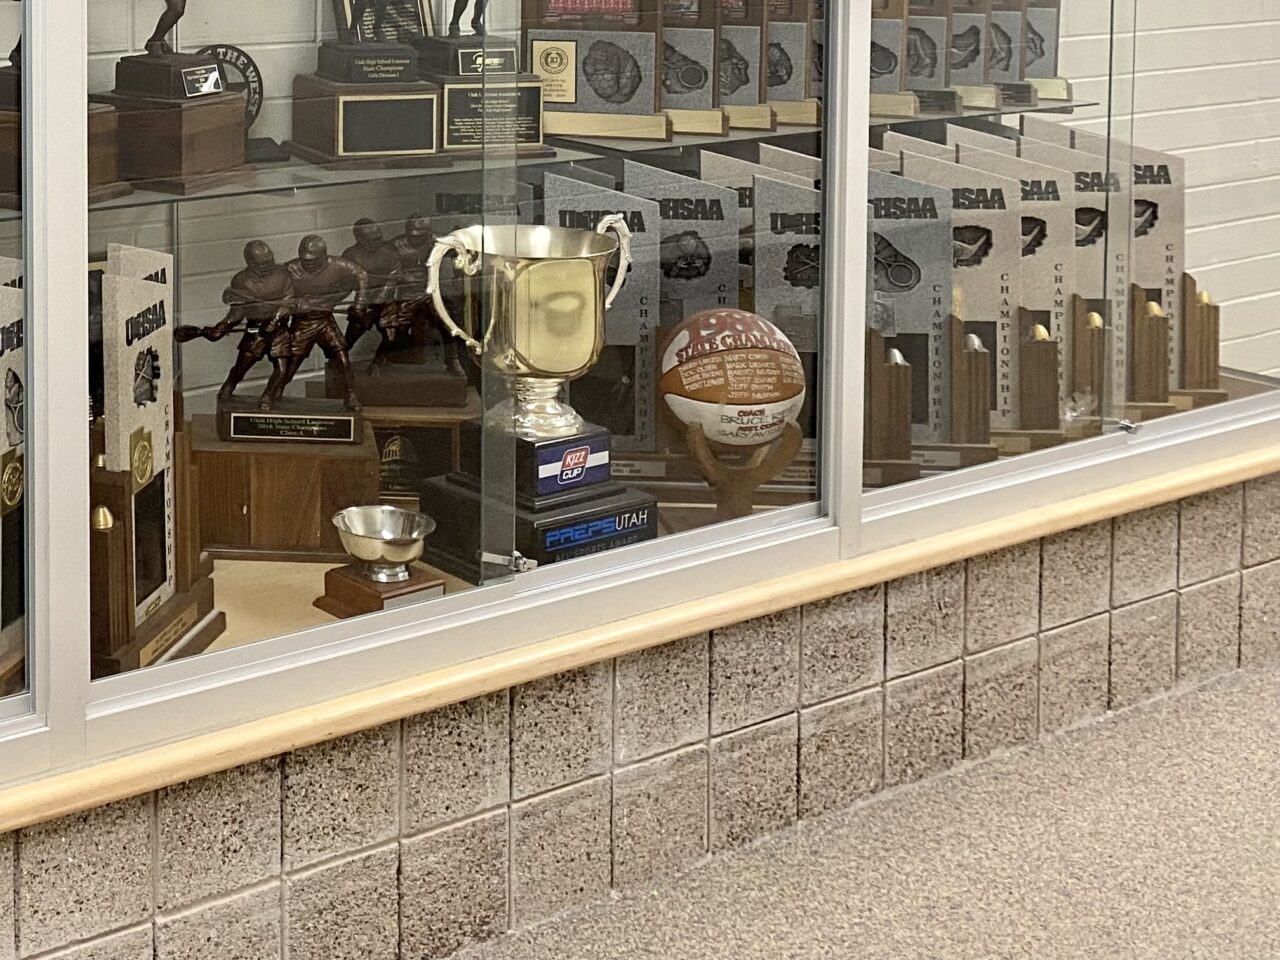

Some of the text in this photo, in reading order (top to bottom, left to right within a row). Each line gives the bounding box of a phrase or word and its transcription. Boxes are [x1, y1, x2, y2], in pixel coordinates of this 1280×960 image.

[217, 47, 260, 115] THE WEST
[1074, 171, 1120, 192] SAA
[654, 197, 724, 221] HSAA
[868, 197, 938, 219] HSAA
[125, 298, 167, 346] UHSAA
[1000, 272, 1010, 419] CHAMPIONSHIP
[932, 283, 942, 432] CHAMPIONSHIP
[720, 414, 768, 425] BRUCE
[737, 409, 765, 417] COACH
[565, 451, 586, 467] KJZZ
[562, 467, 582, 480] CUP
